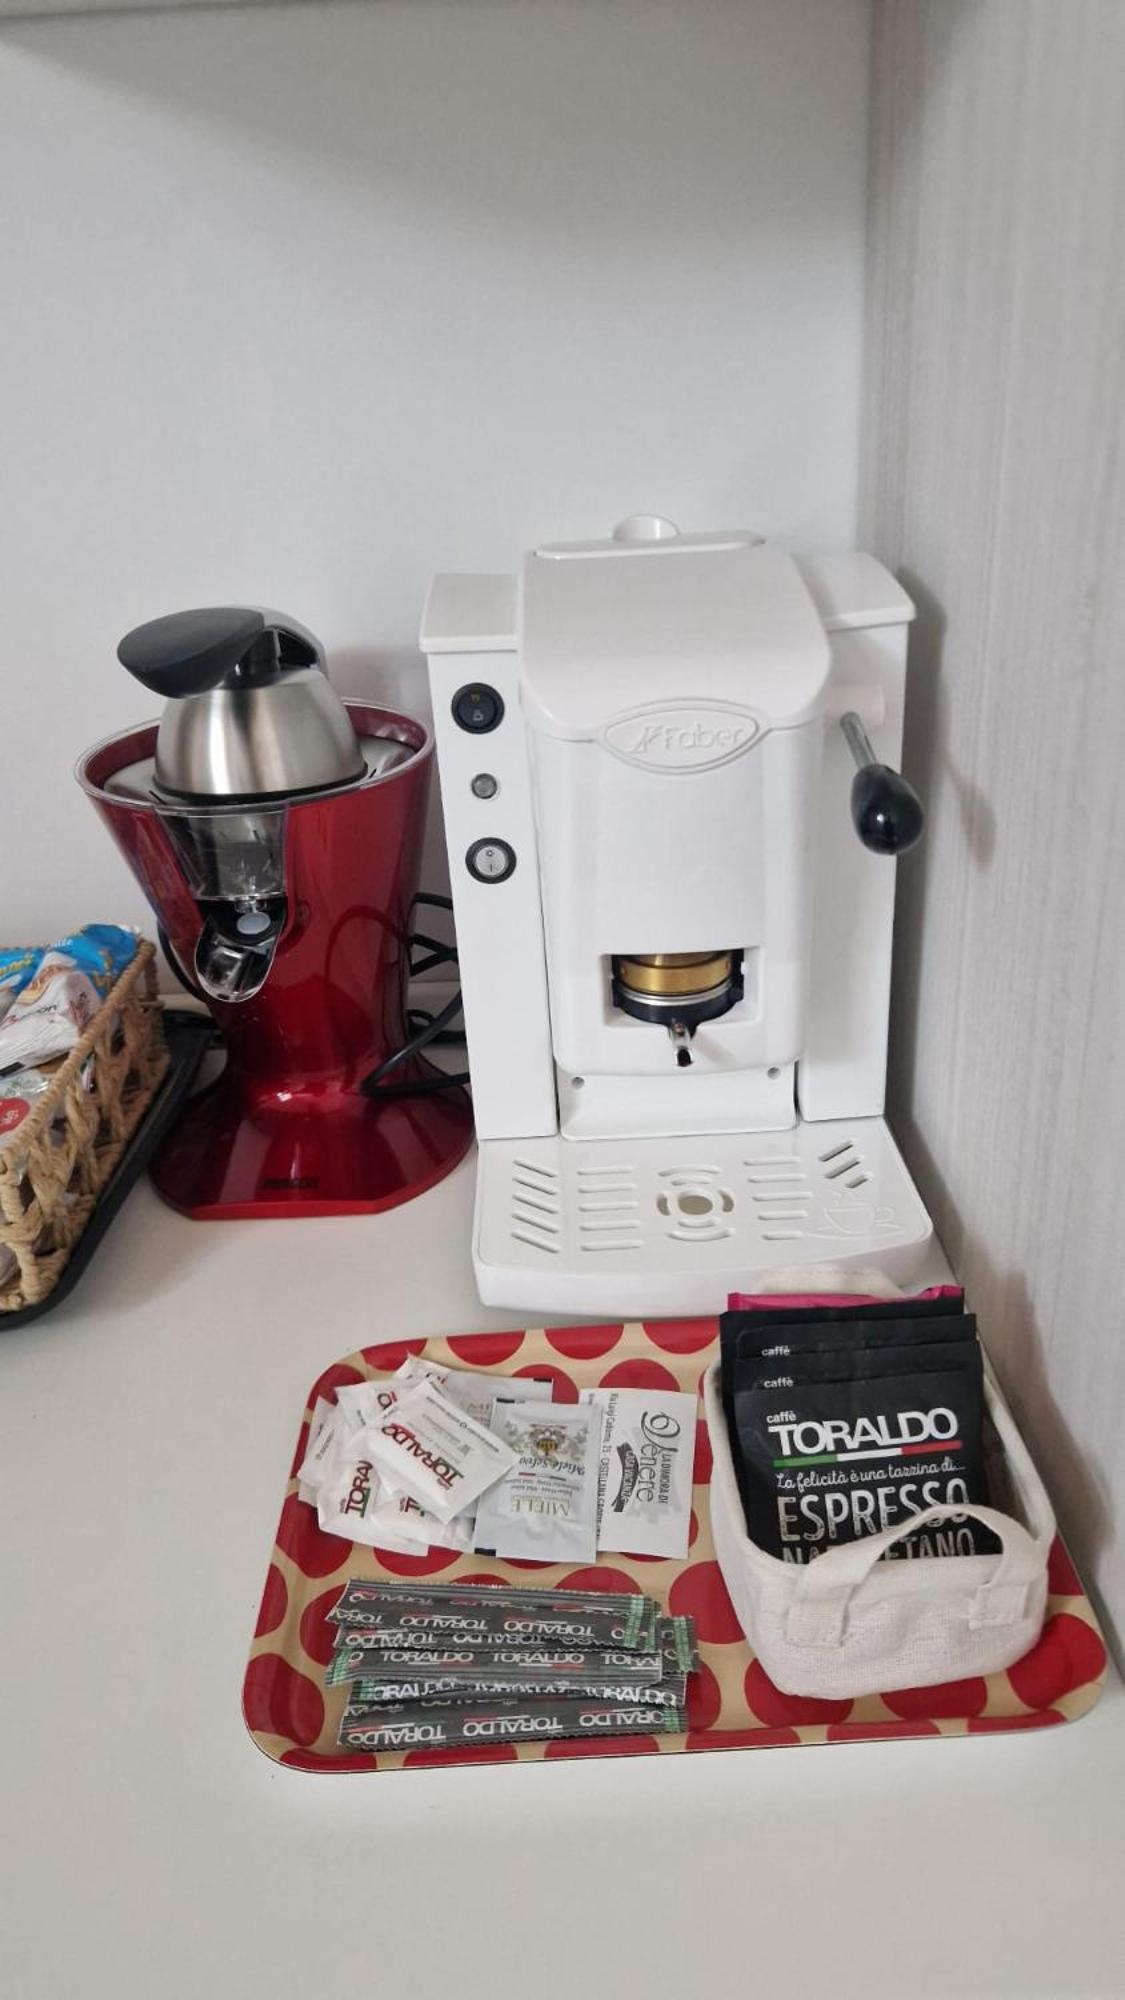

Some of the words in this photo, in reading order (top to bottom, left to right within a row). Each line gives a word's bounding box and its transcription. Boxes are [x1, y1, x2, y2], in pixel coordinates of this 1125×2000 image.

[664, 720, 744, 750] Faber
[761, 1344, 791, 1358] caffè
[763, 1376, 794, 1389] caffè
[766, 1410, 797, 1424] caffè
[768, 1406, 959, 1457] TORALDO
[382, 1424, 454, 1488] TORALDO
[637, 1410, 681, 1503] Venere
[776, 1472, 797, 1490] La
[796, 1464, 848, 1492] felicità
[850, 1467, 859, 1483] è
[859, 1467, 888, 1482] una
[888, 1463, 945, 1479] tazzina
[777, 1477, 970, 1542] ESPRESSO
[400, 1615, 488, 1631] TORALDO
[504, 1620, 595, 1637] TORALDO
[345, 1632, 438, 1649] TORALDO
[383, 1651, 475, 1663] TORALDO
[492, 1651, 585, 1664] TORALDO
[347, 1724, 447, 1745] TORALDO
[463, 1716, 563, 1737] TORALDO
